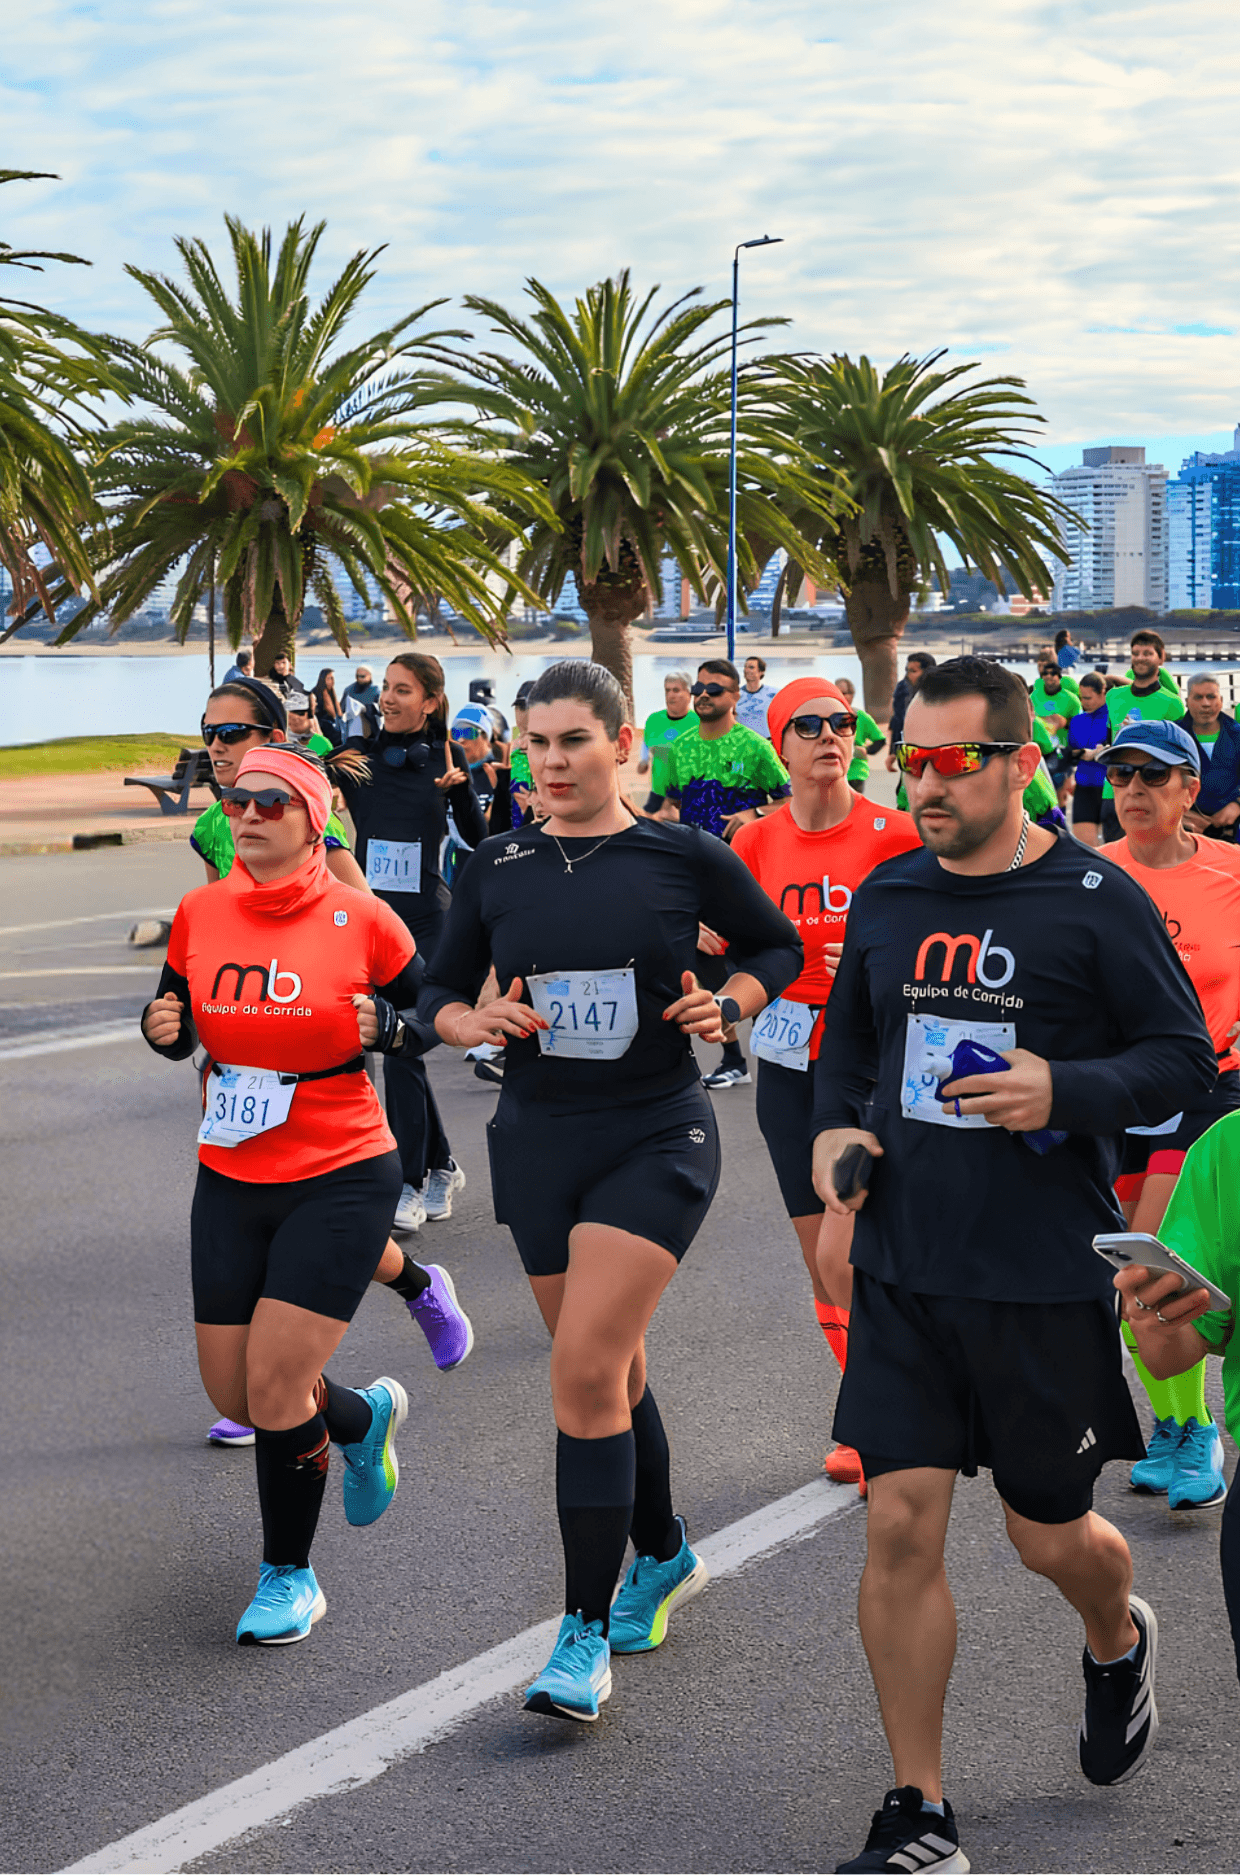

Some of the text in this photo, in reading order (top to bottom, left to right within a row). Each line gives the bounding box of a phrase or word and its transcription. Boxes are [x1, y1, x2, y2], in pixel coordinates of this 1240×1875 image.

[373, 856, 410, 877] 8711
[780, 874, 853, 915] mb
[914, 928, 1016, 989] mb
[210, 958, 303, 1004] mb
[581, 980, 600, 996] 21
[550, 1000, 619, 1032] 2147
[758, 1012, 803, 1047] 2076
[215, 1092, 270, 1127] 3181
